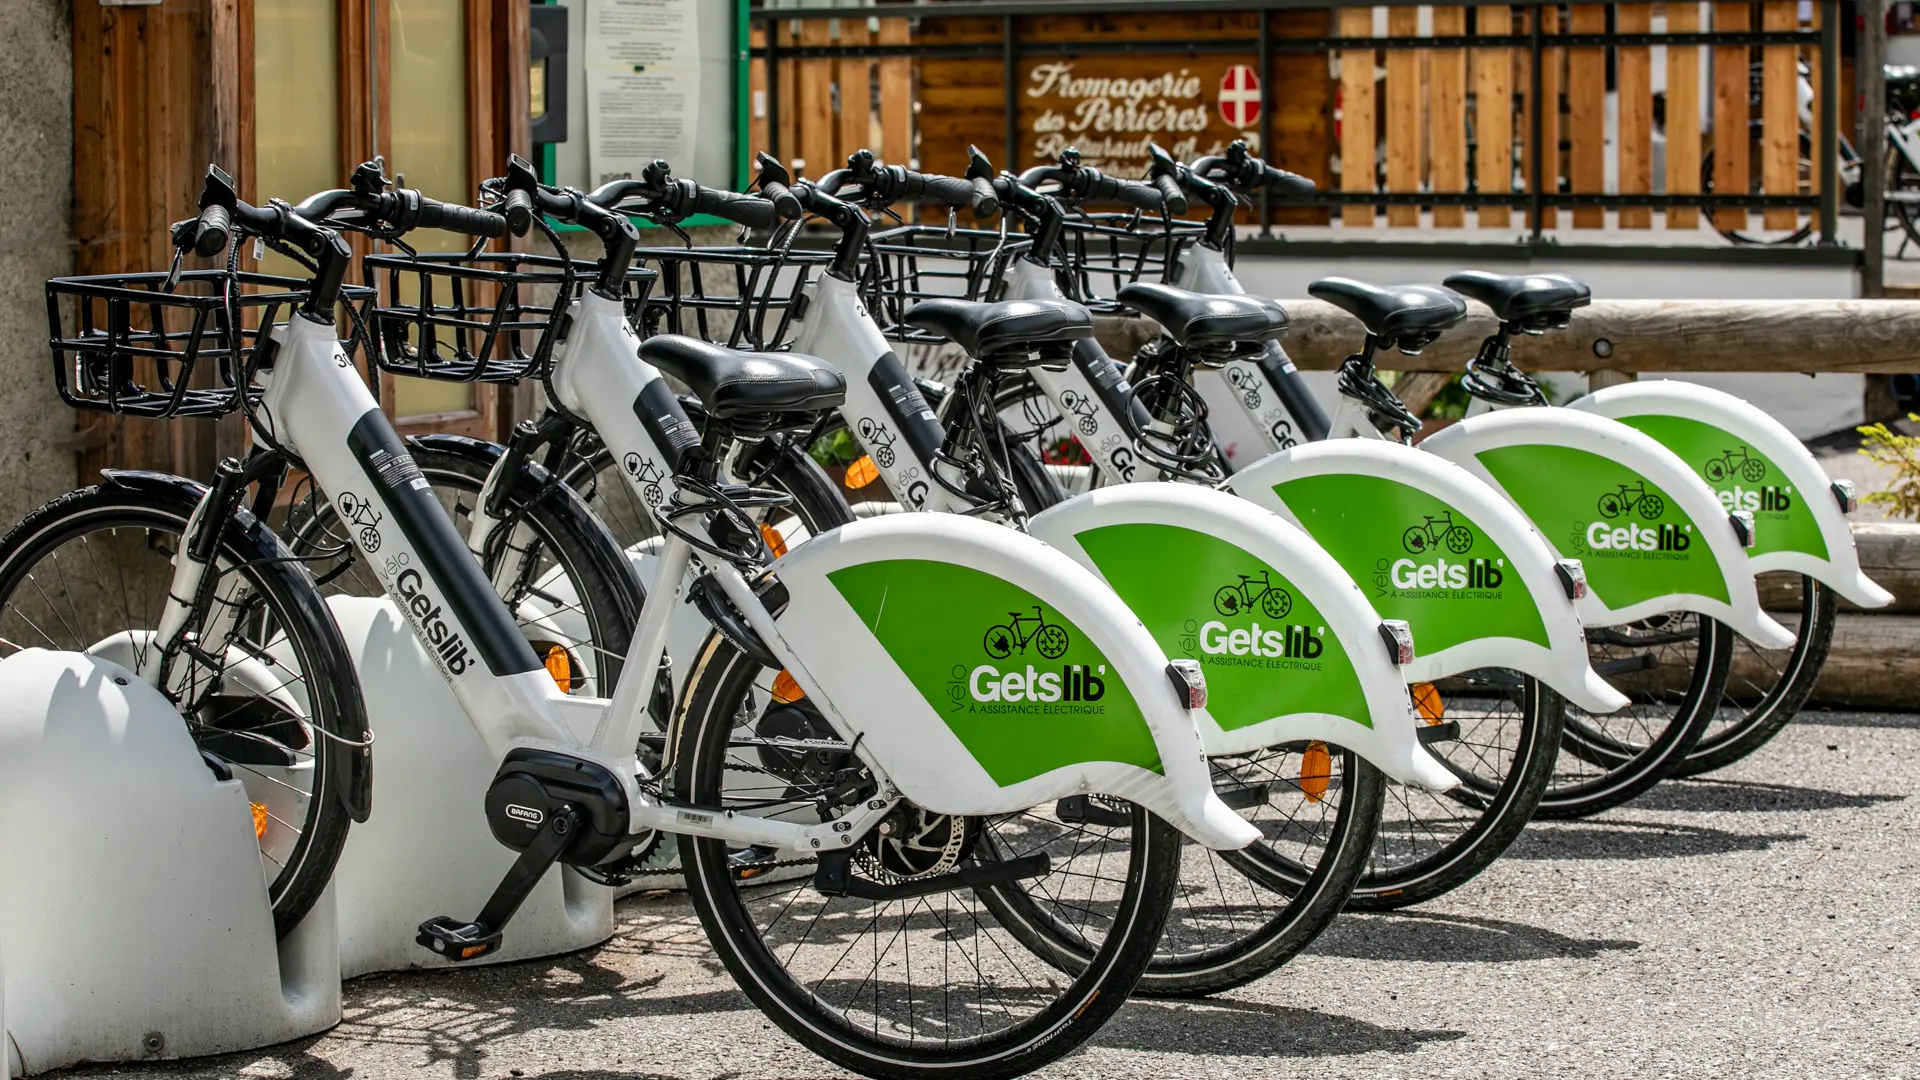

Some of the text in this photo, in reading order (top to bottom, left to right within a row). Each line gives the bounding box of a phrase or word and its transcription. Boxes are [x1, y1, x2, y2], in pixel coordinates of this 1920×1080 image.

[1027, 62, 1201, 105] Fromagerie
[1033, 100, 1208, 133] des Perrières
[893, 467, 919, 490] vélo
[1714, 485, 1792, 511] etslib'
[1569, 521, 1585, 555] vélo
[1587, 521, 1692, 551] Getslib'
[380, 552, 409, 580] vélo
[1595, 550, 1641, 559] ASSISTANCE
[1372, 558, 1389, 598] vélo
[1390, 558, 1504, 590] Getslib'
[1400, 591, 1449, 599] ASSISTANCE
[1452, 590, 1503, 600] ÉLECTRIQUE
[393, 592, 424, 637] ASSISTANCE
[397, 568, 475, 676] Getslib'
[1199, 620, 1325, 659] Getslib'
[1208, 657, 1263, 668] ASSISTANCE
[1266, 658, 1322, 671] ÉLECTRIQUE
[946, 664, 967, 713] vélo
[969, 664, 1106, 702] Getslib'
[969, 702, 1105, 715] À ASSISTANCE ÉLECTRIQUE
[511, 807, 538, 819] BAFANG
